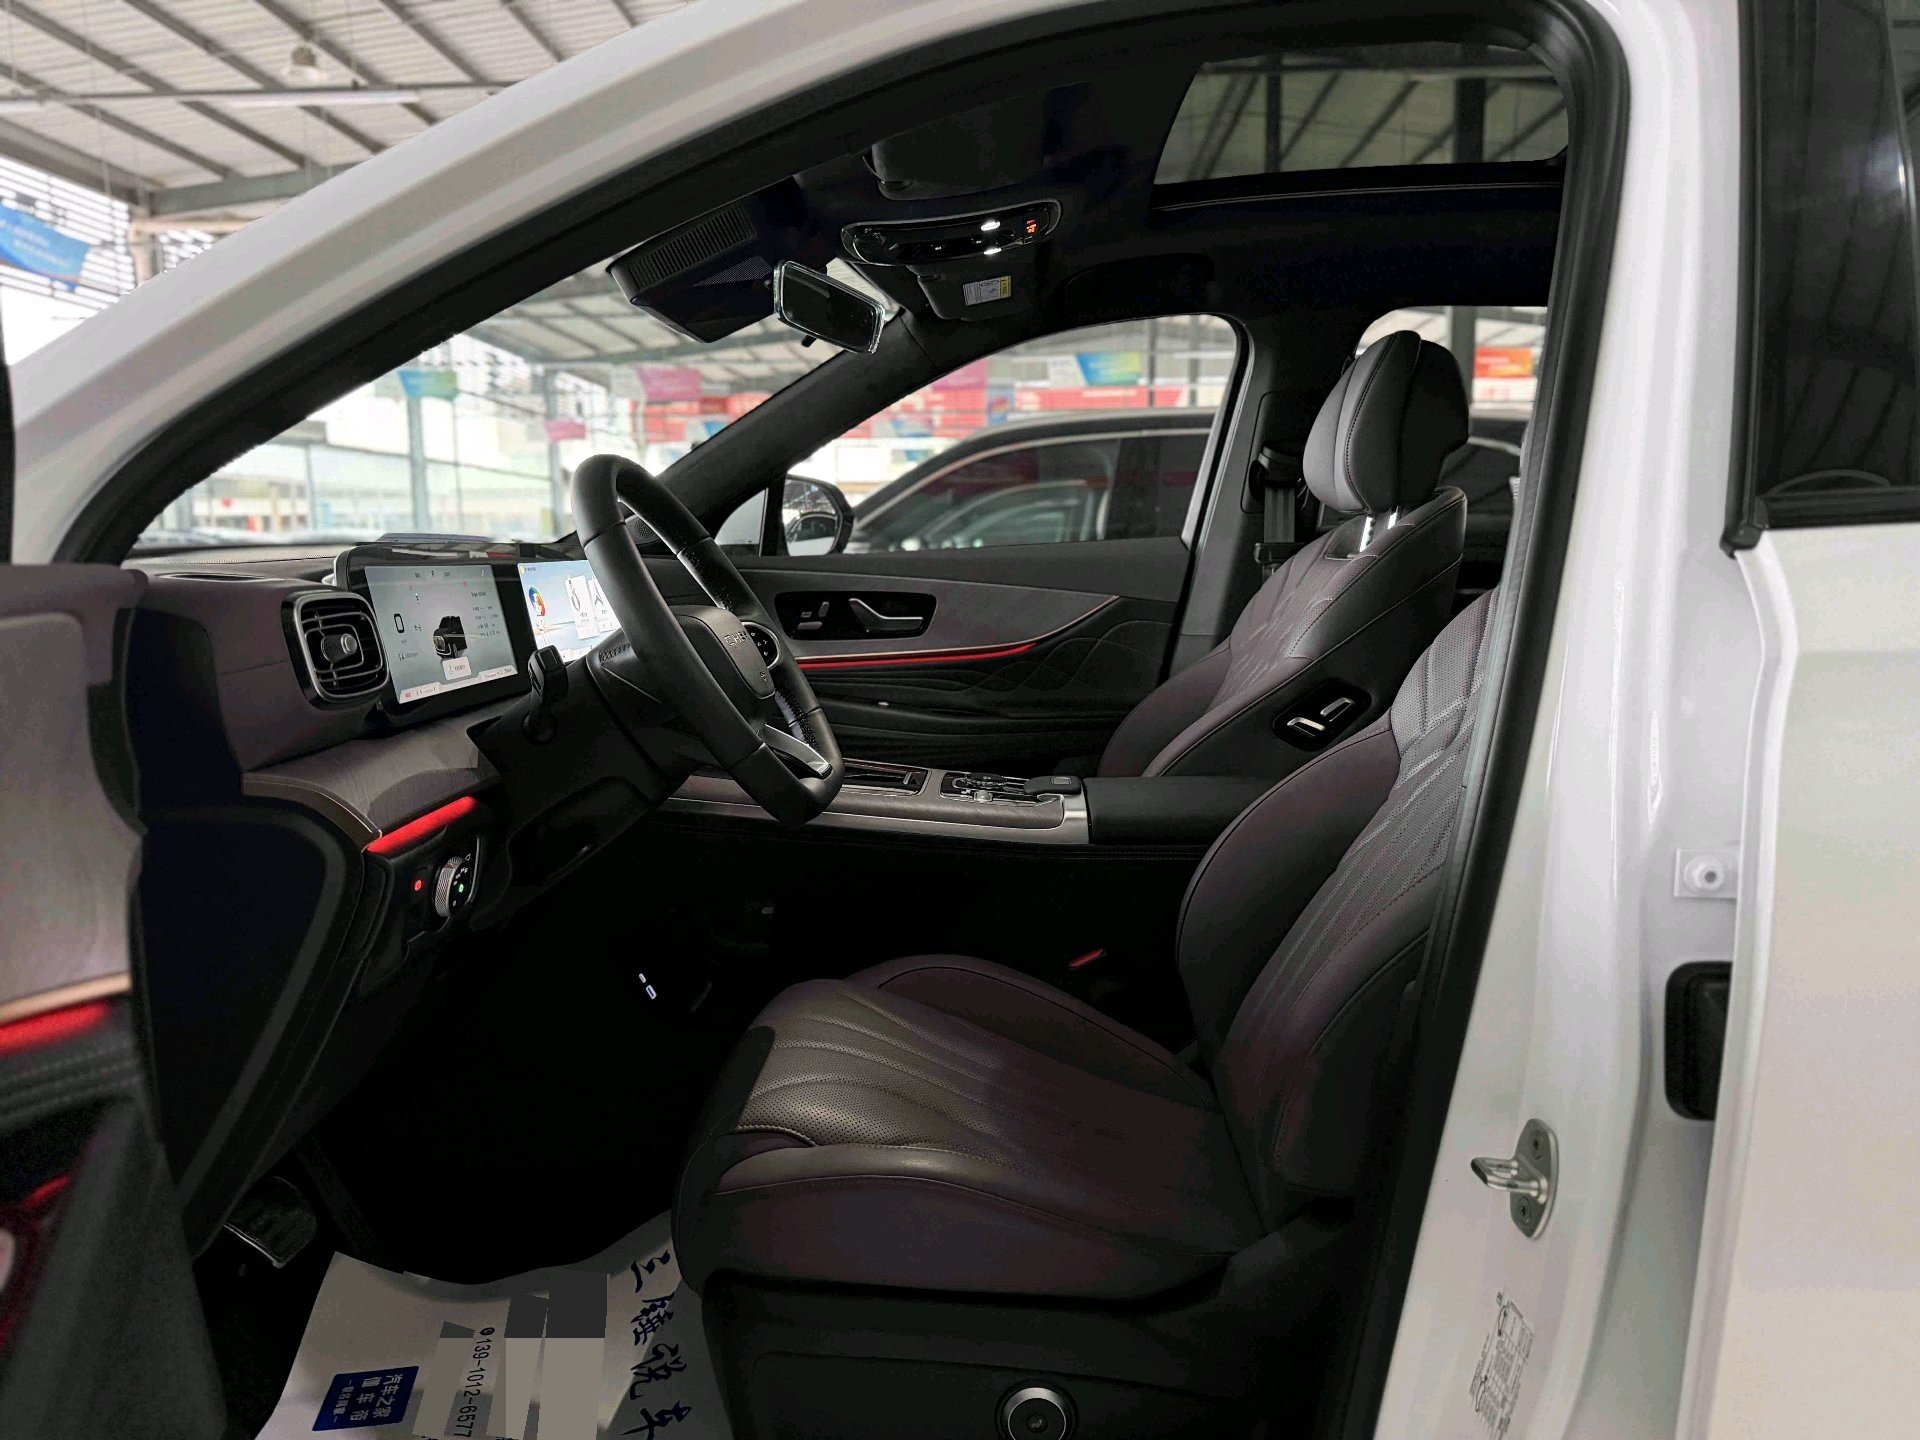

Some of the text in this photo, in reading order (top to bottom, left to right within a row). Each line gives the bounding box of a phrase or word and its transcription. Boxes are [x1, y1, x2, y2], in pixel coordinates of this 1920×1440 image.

[372, 1373, 403, 1418] 汽车之家
[453, 1338, 493, 1437] 139-1012-6577
